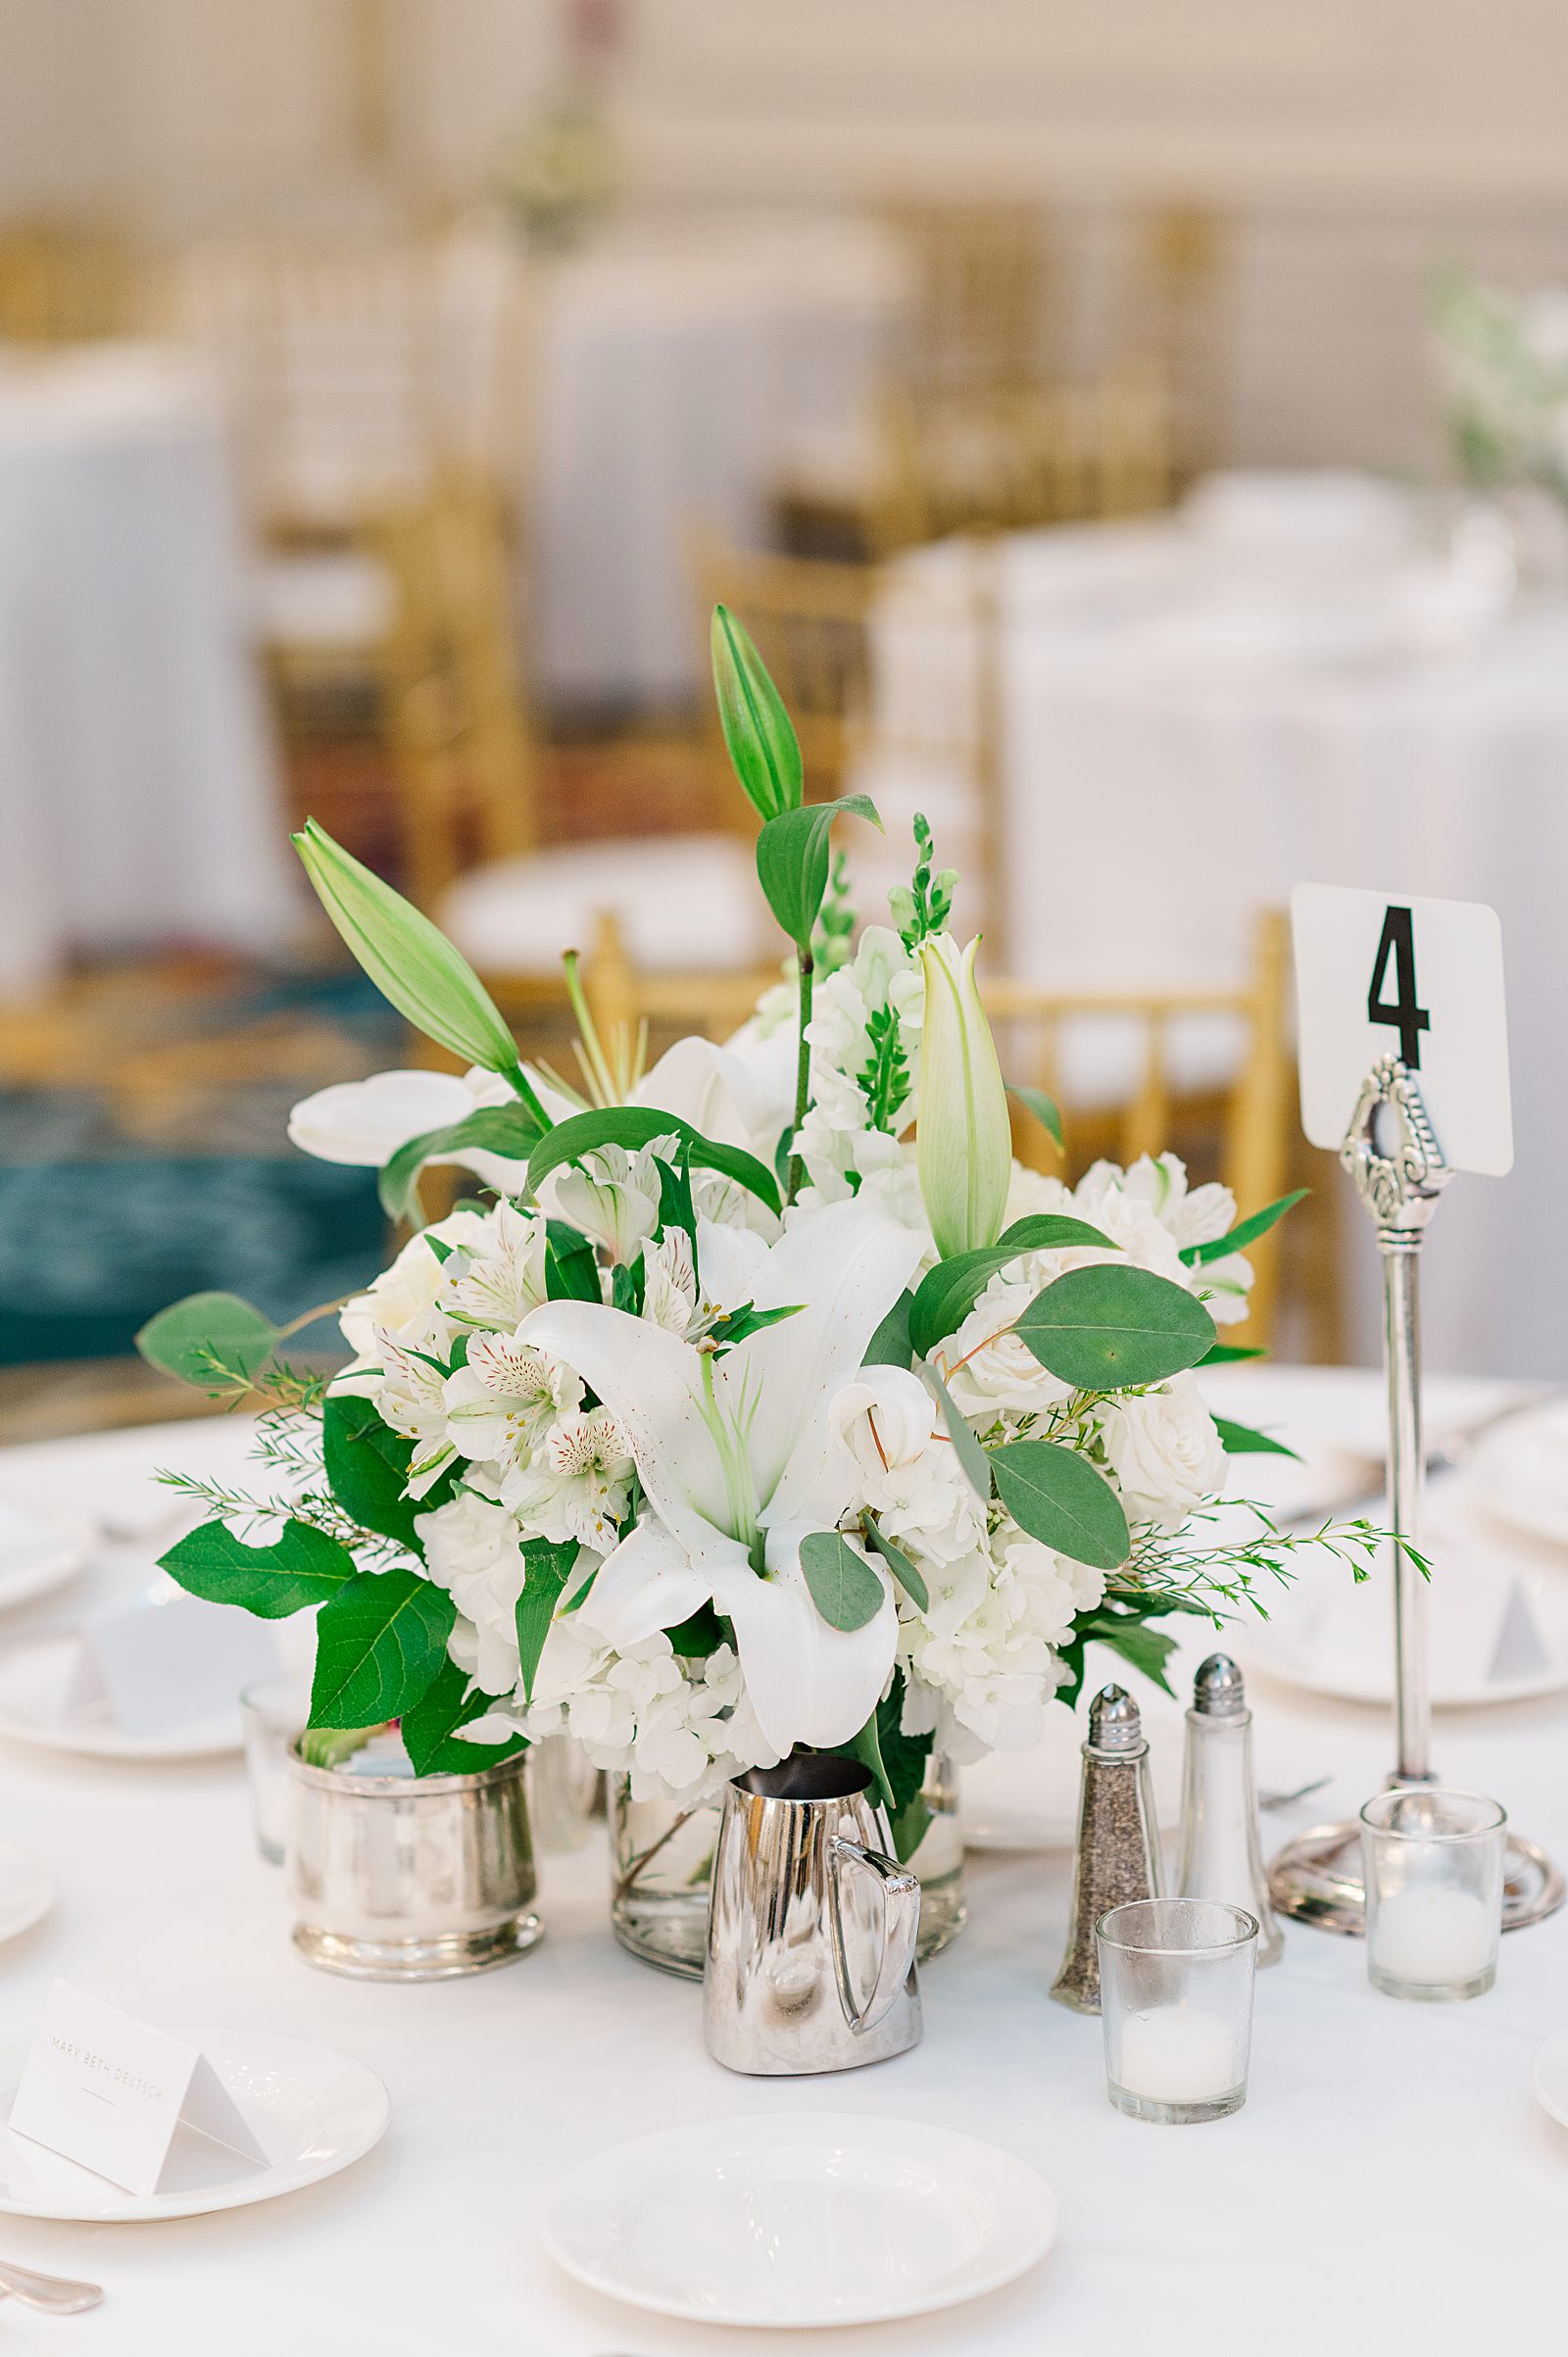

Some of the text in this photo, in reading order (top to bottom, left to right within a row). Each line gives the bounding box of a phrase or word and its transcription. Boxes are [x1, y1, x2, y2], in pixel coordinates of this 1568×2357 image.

[1368, 906, 1430, 1070] 4
[51, 2037, 164, 2100] MARY BETH DEUTSCH
